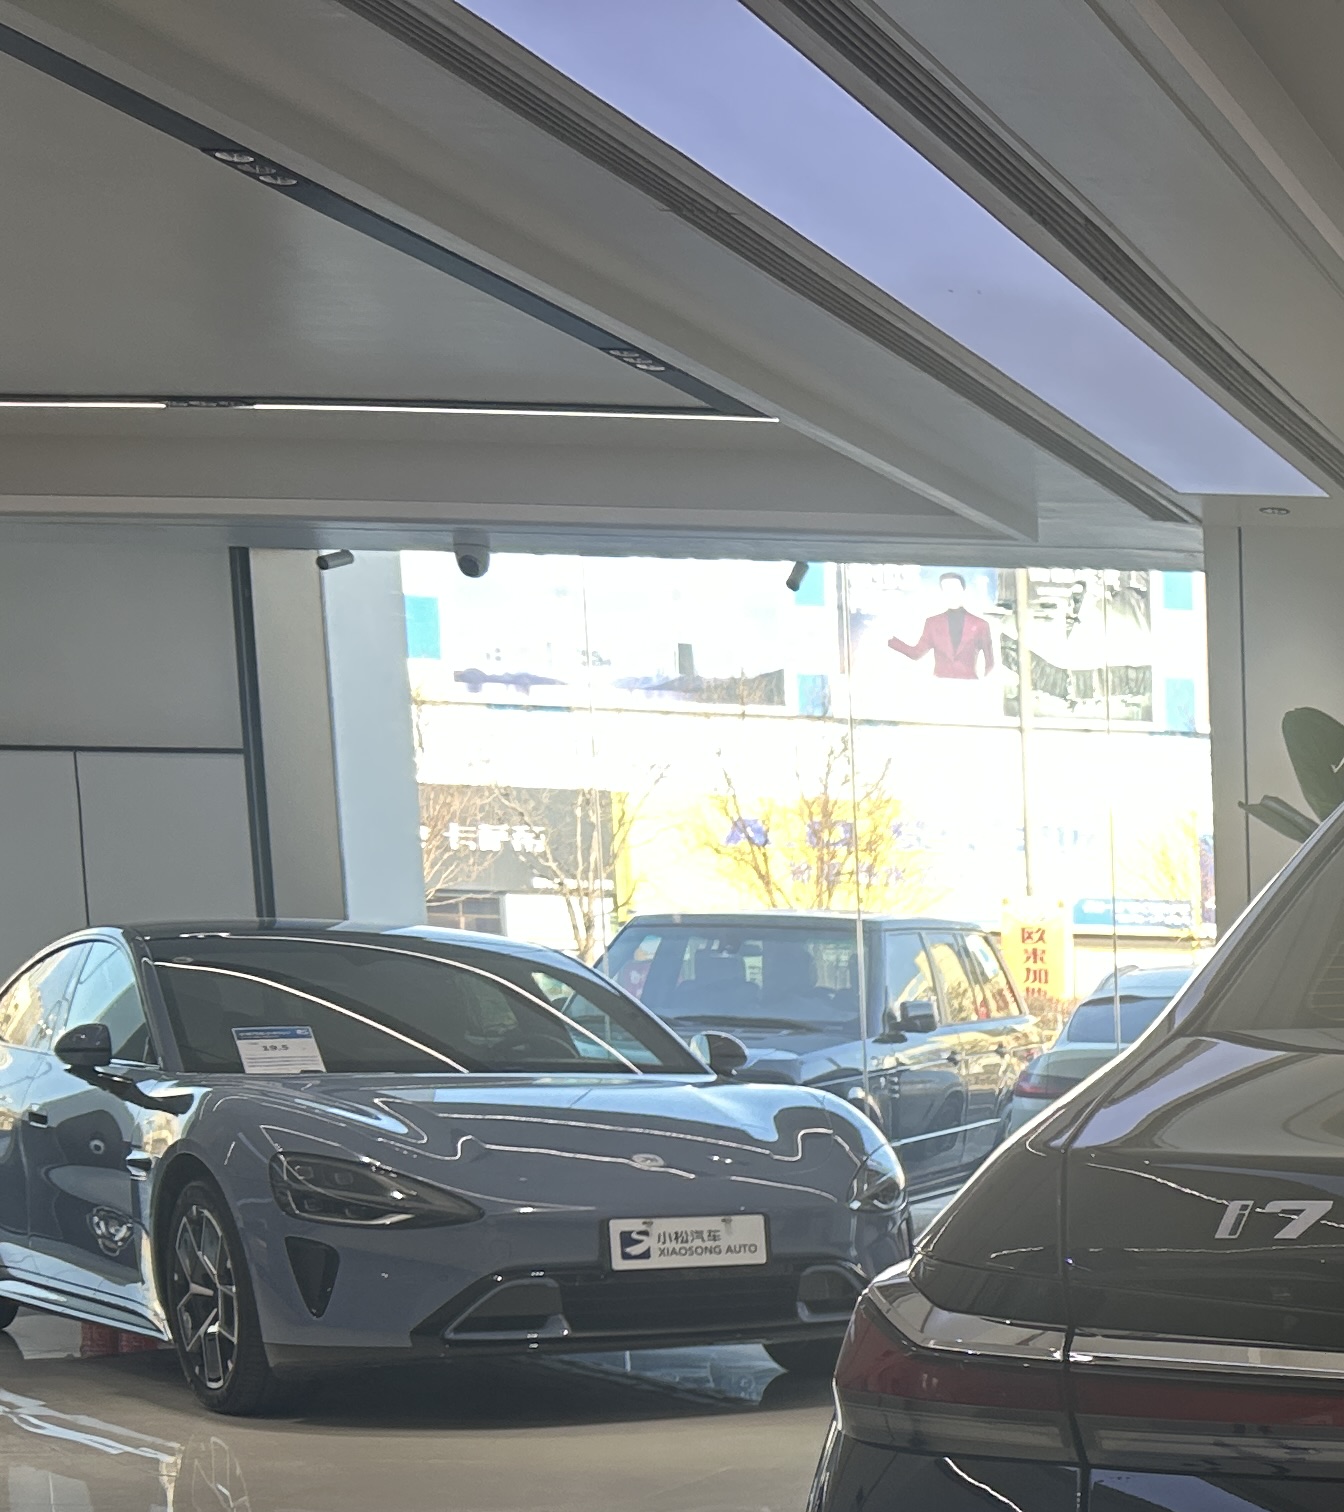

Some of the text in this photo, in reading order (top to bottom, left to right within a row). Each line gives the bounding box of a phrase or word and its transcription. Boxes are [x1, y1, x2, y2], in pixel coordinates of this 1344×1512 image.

[1214, 1199, 1334, 1240] i7
[656, 1229, 722, 1245] 小松汽车
[658, 1243, 758, 1258] XIAOSONG AUTO
